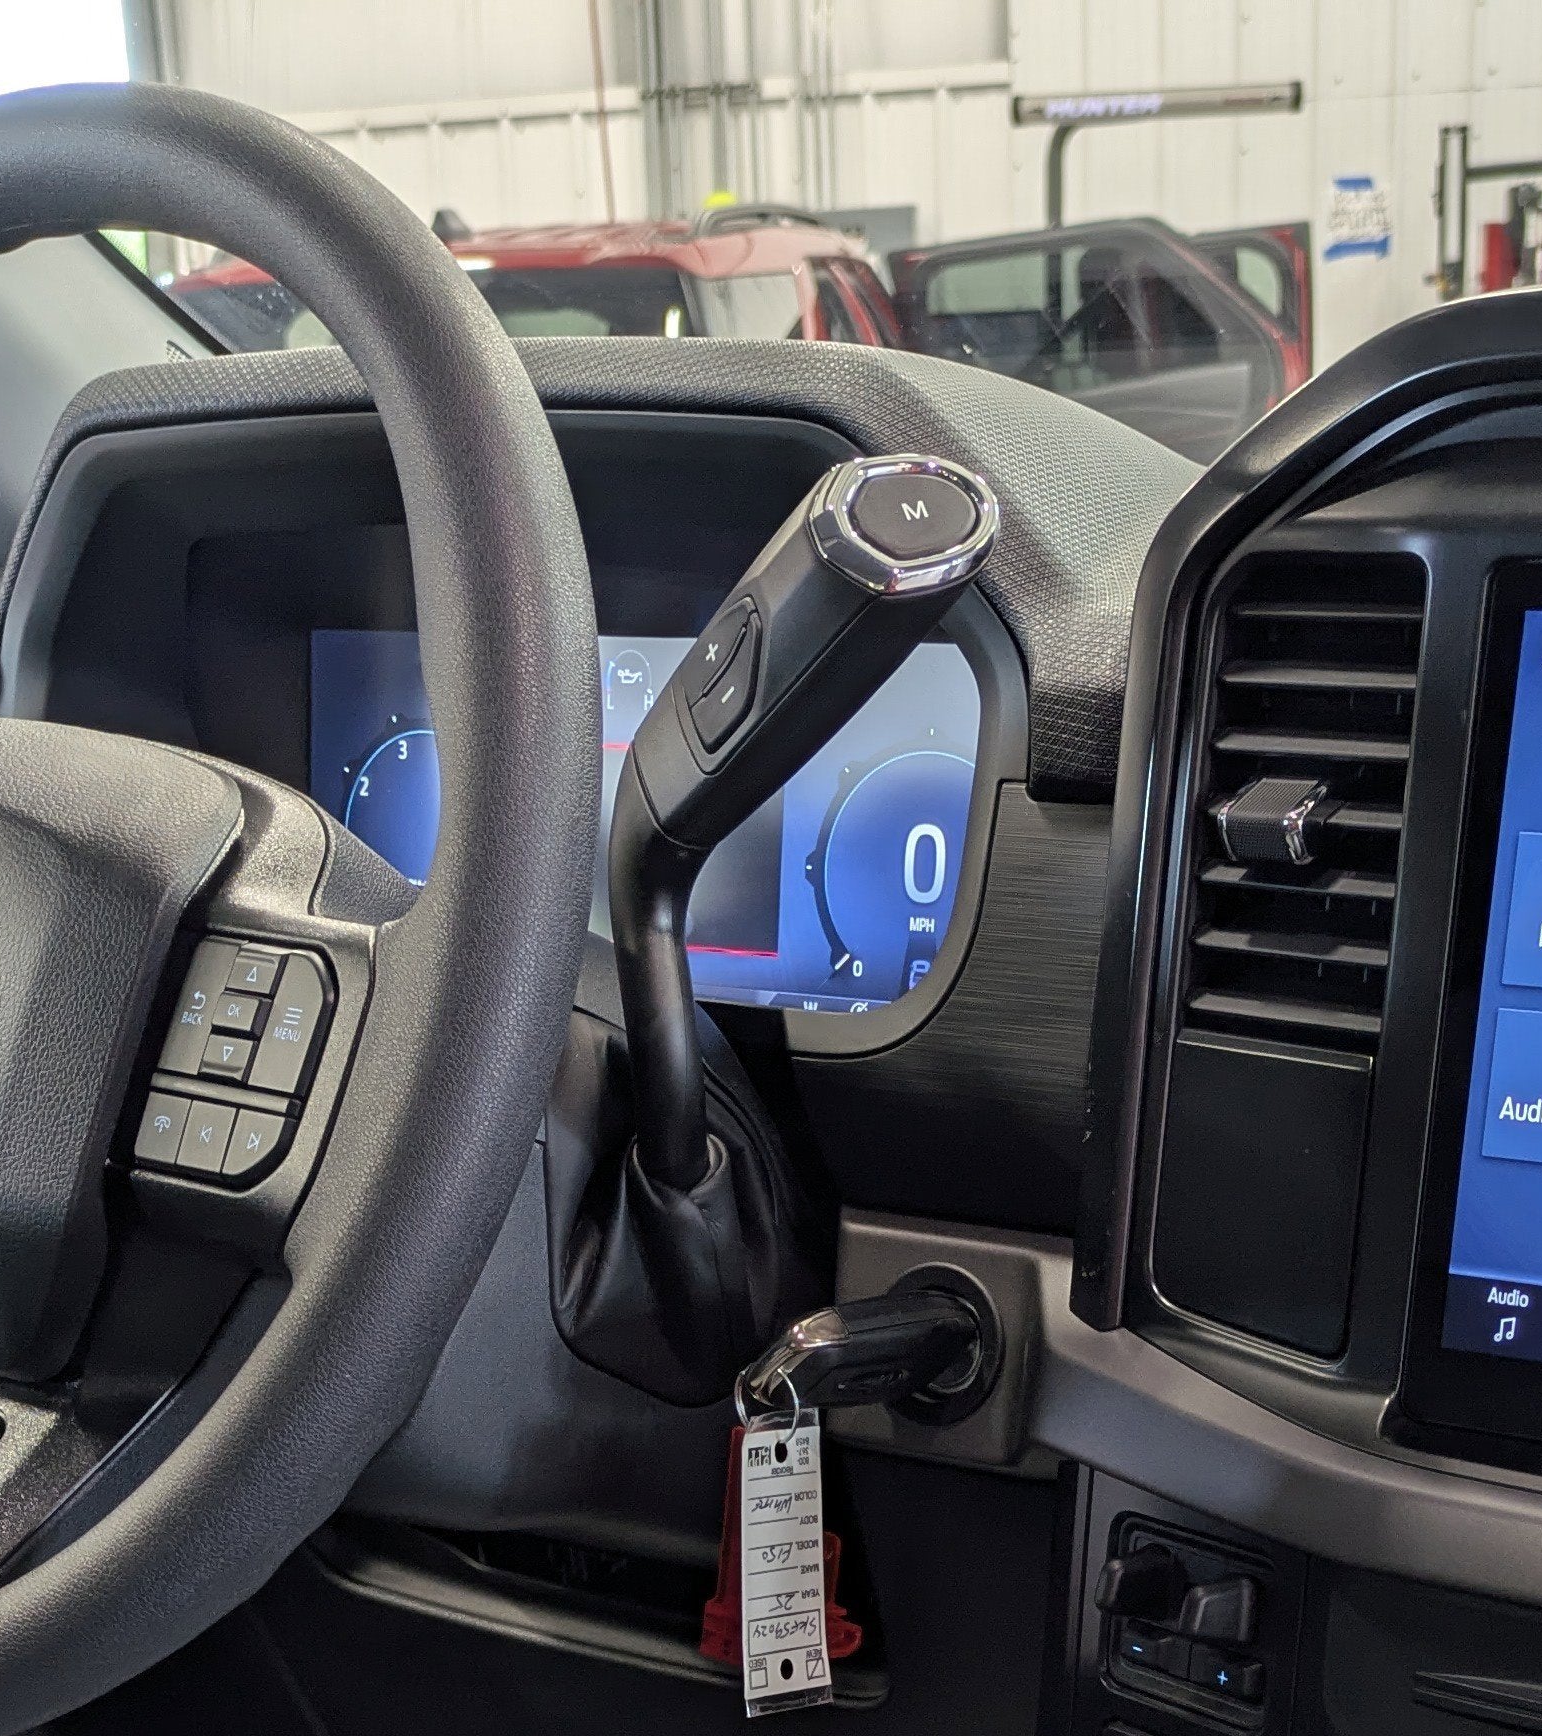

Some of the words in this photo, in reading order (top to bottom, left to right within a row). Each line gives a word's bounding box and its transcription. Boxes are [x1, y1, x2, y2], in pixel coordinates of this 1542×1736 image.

[901, 500, 929, 521] M
[397, 739, 408, 760] 3
[359, 776, 370, 797] 2
[903, 822, 947, 905] 0
[909, 916, 935, 933] MPH
[852, 960, 863, 977] 0
[181, 1011, 204, 1026] BACK
[228, 1004, 242, 1018] OK
[273, 1026, 302, 1043] MENU
[1487, 1286, 1530, 1309] Audio
[794, 1491, 818, 1502] COLOR
[799, 1515, 819, 1526] BODY
[795, 1539, 819, 1550] MODEL
[800, 1563, 820, 1575] MAKE
[801, 1588, 820, 1599] YEAR
[749, 1657, 767, 1669] USED
